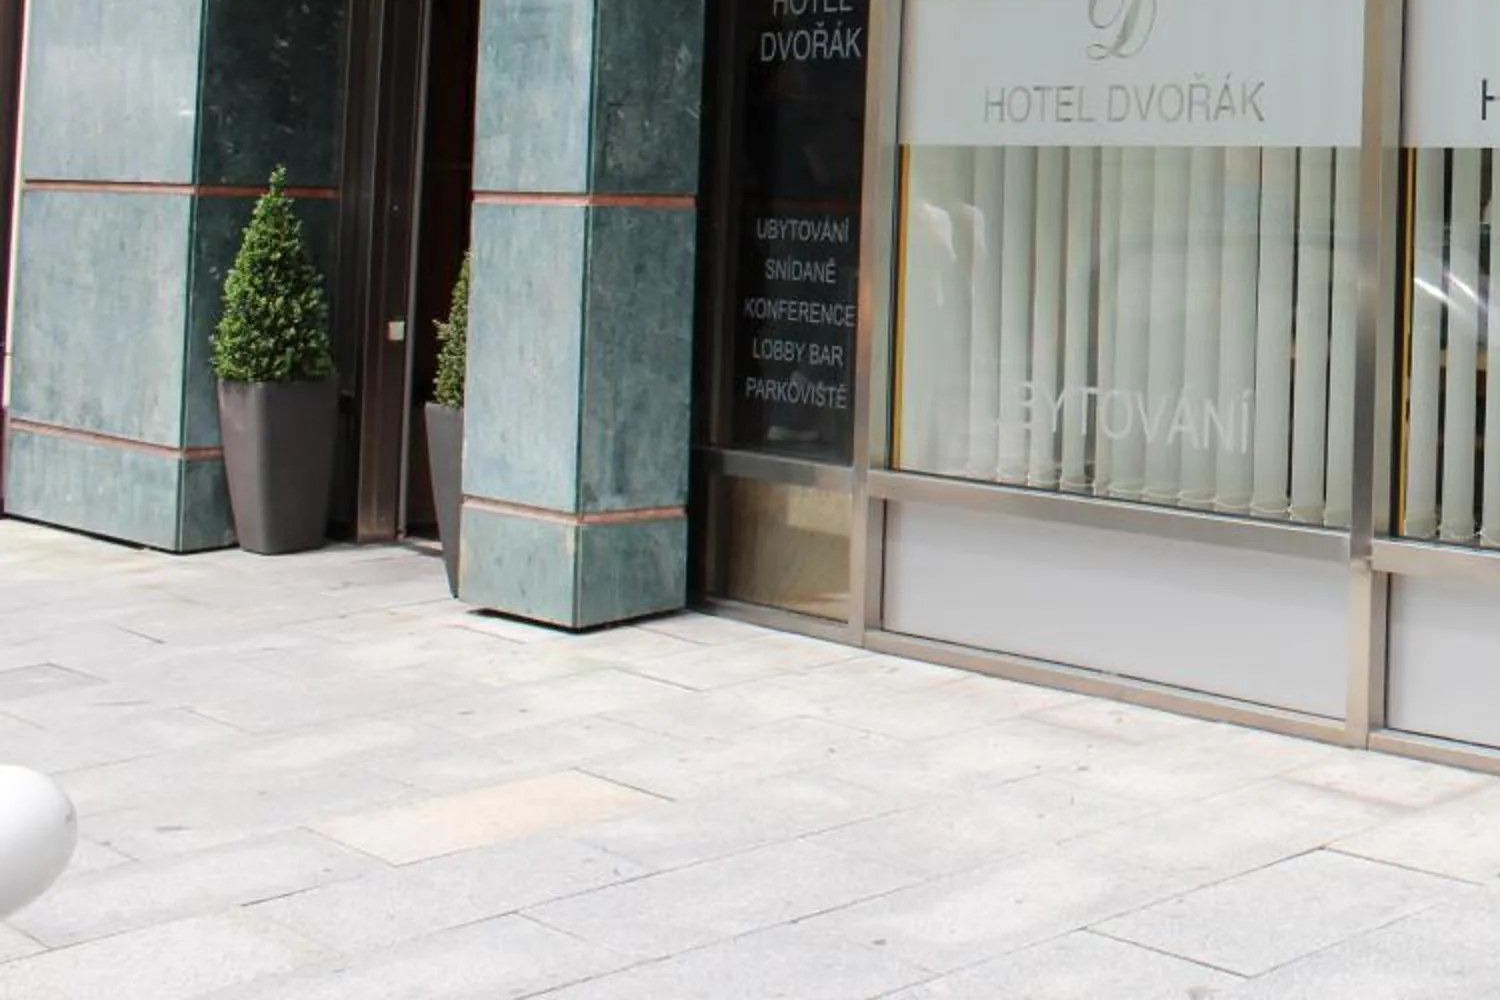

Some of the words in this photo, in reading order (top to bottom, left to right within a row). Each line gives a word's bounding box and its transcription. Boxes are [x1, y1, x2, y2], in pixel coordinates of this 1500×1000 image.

[760, 19, 863, 62] DVOŘÁK
[982, 85, 1097, 125] HOTEL
[1107, 72, 1266, 124] DVOŘÁK
[743, 297, 857, 327] KONFERENCE
[752, 337, 807, 363] LOBBY
[809, 343, 845, 367] BAR
